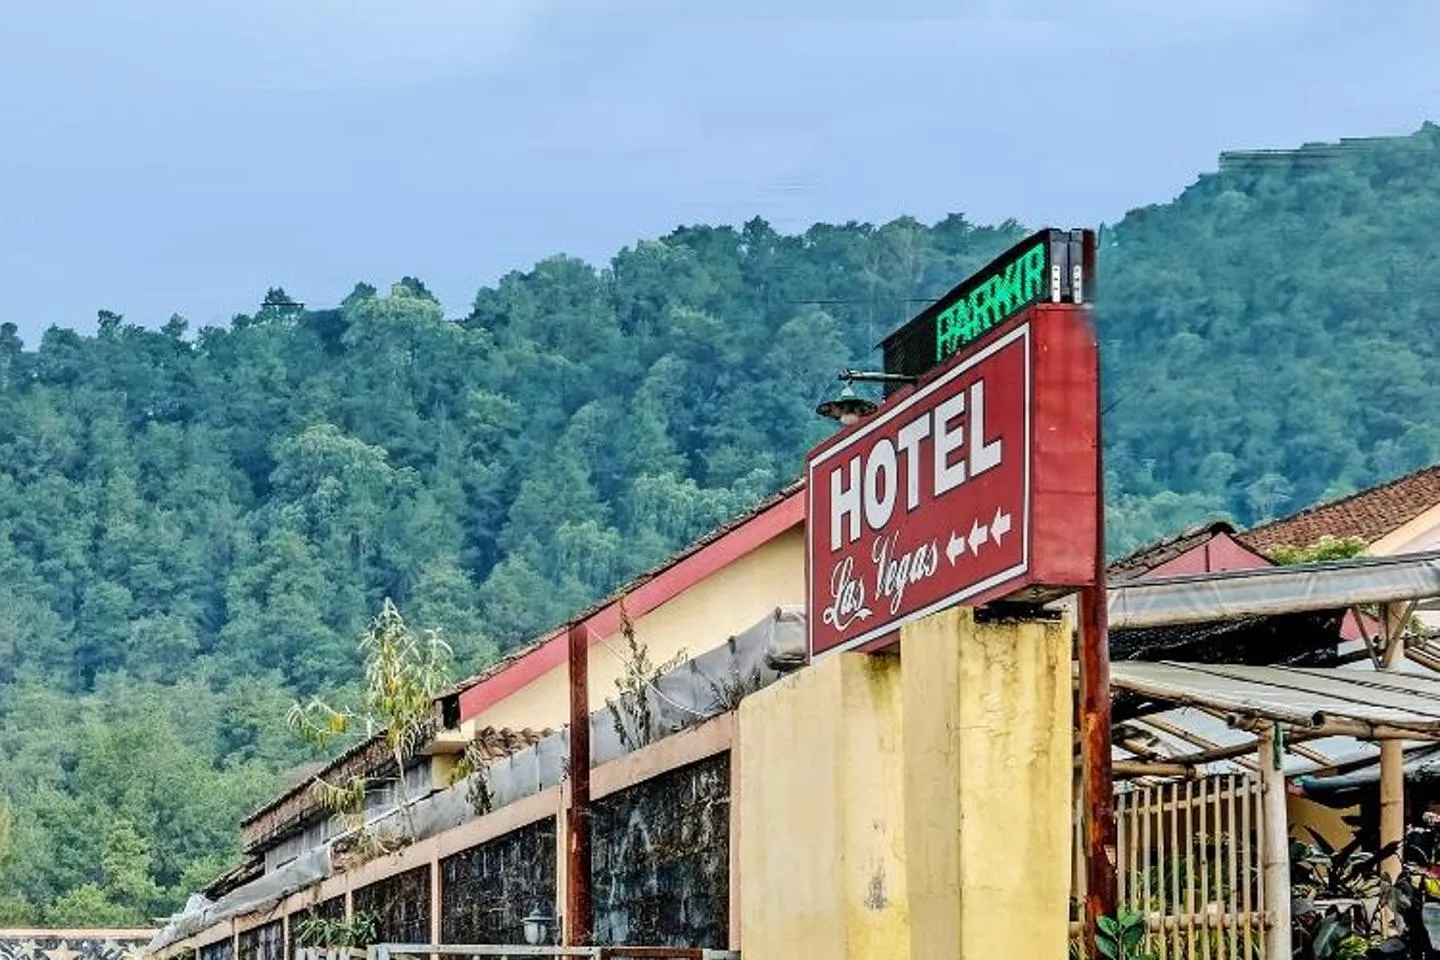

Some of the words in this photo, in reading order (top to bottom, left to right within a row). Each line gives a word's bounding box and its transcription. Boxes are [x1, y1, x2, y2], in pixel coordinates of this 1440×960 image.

[830, 378, 1002, 552] HOTEL
[822, 555, 873, 630] Las
[871, 530, 938, 616] Vegas
